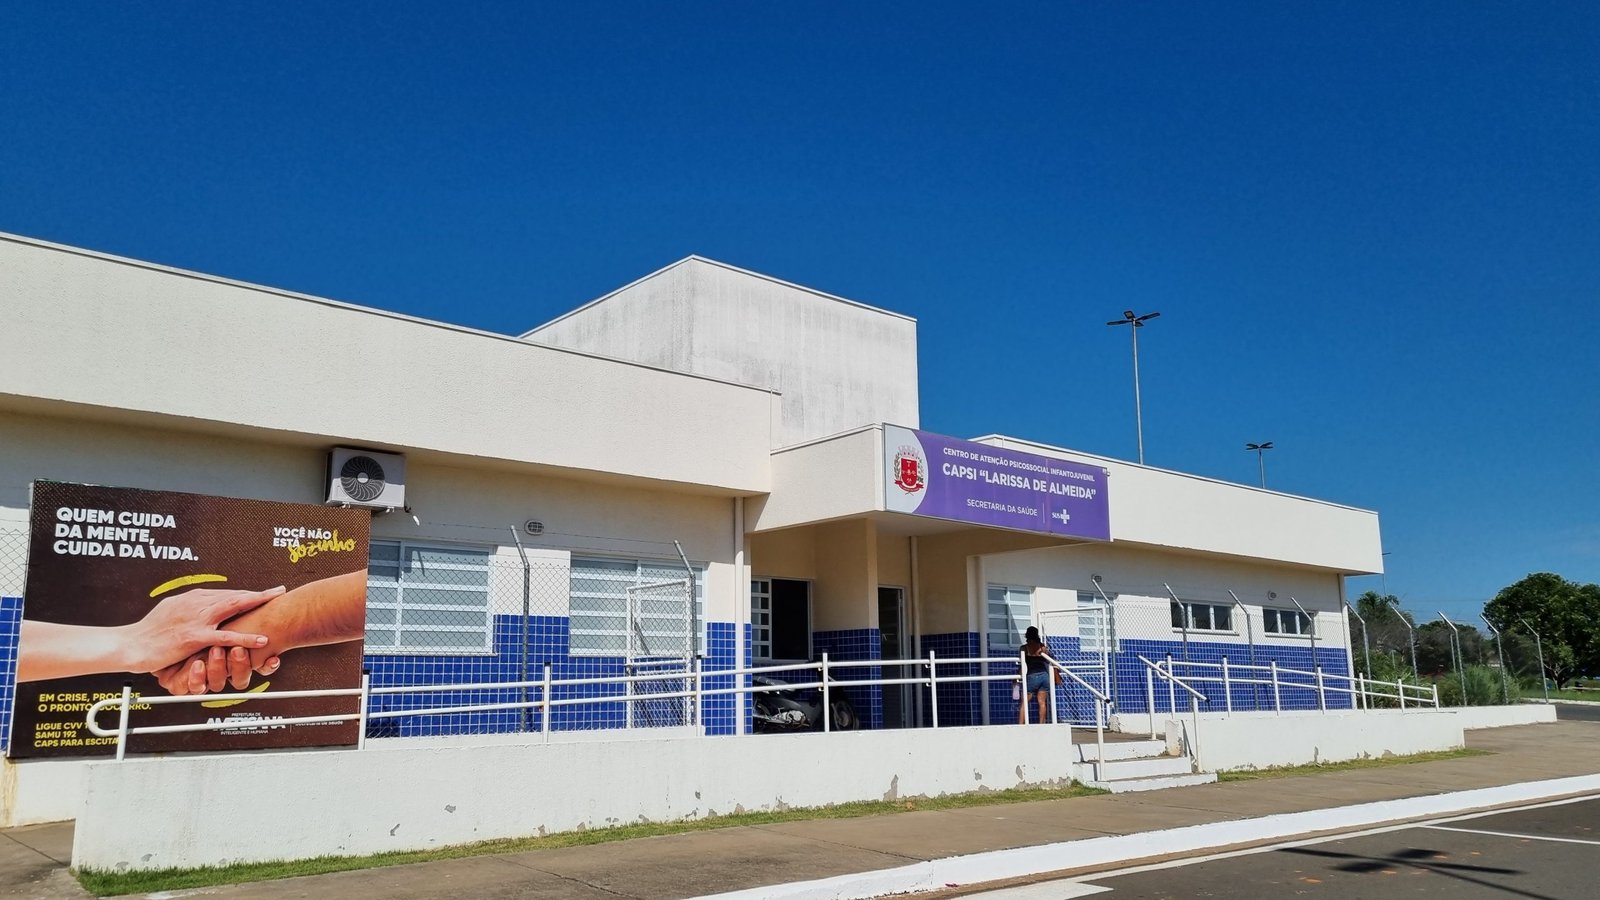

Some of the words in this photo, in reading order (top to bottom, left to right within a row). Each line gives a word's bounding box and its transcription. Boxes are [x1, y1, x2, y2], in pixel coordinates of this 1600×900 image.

[943, 447, 969, 459] CENTRO
[970, 452, 979, 461] DE
[980, 454, 1009, 467] ATENÇÃO
[1009, 460, 1050, 474] PSICOSSOCIAL
[1050, 467, 1095, 482] INFANTOJUVENIL
[943, 462, 977, 481] CAPSI
[1032, 478, 1047, 493] DE
[966, 498, 1007, 512] SECRETARIA
[1007, 504, 1016, 513] DA
[1017, 505, 1038, 517] SAÚDE
[56, 506, 115, 525] QUEM
[118, 511, 177, 529] CUIDA
[54, 523, 83, 539] DA
[86, 525, 155, 545] MENTE,
[273, 526, 306, 538] VOCÊ
[307, 528, 332, 540] NÃO
[53, 539, 116, 557] CUIDA
[118, 543, 146, 559] DA
[149, 545, 199, 561] VIDA.
[39, 693, 55, 702] EM
[57, 693, 90, 702] CRISE,
[93, 692, 141, 701] PROCRE
[38, 703, 48, 712] O
[35, 731, 61, 739] SAMU
[62, 730, 77, 738] 192
[36, 722, 62, 731] LIGUE
[63, 722, 83, 730] CVV
[34, 739, 59, 747] CAPS
[60, 739, 84, 747] PARA
